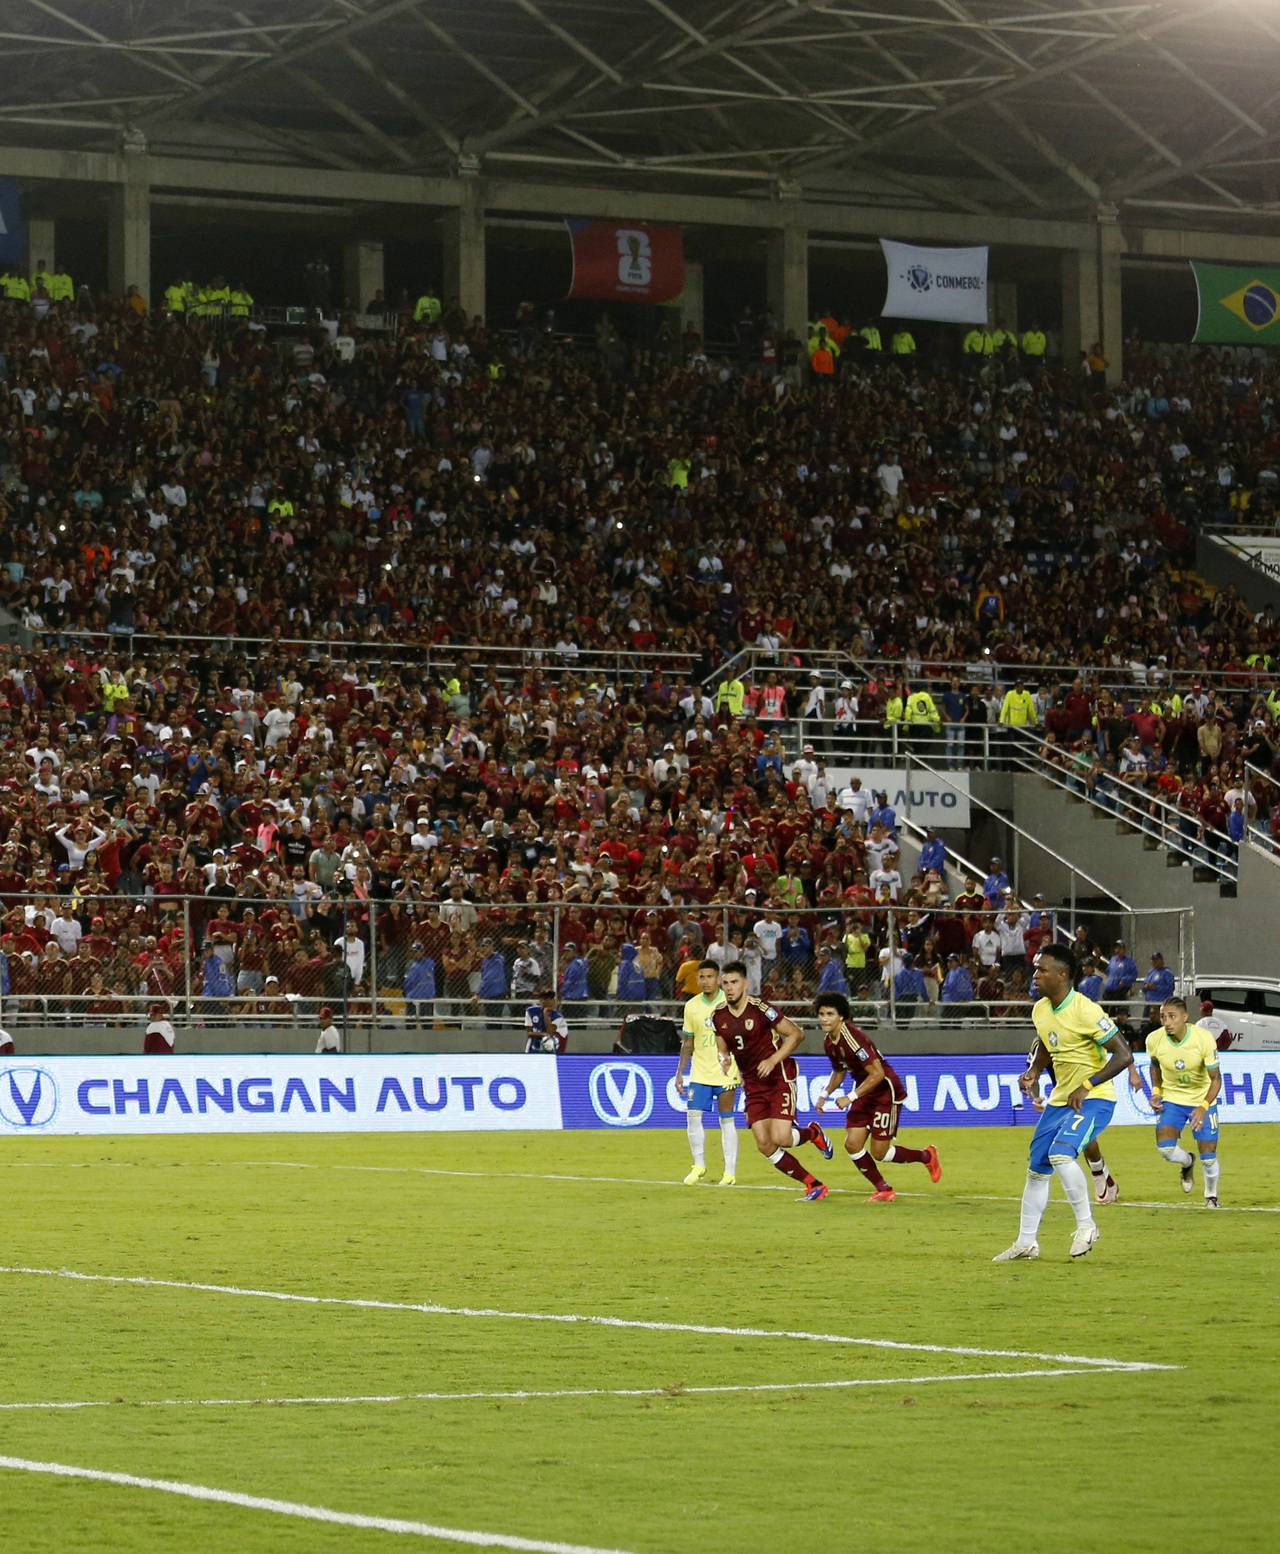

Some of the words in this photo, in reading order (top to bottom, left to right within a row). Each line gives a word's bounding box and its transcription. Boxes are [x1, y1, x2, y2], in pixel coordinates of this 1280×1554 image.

[936, 275, 981, 290] CONMEBOL
[894, 789, 957, 808] AUTO
[734, 1035, 744, 1051] 3
[77, 1077, 356, 1115] CHANGAN
[376, 1076, 527, 1112] AUTO
[781, 1092, 790, 1108] 3
[873, 1112, 890, 1129] 20
[1070, 1114, 1085, 1131] 7
[1208, 1112, 1219, 1130] 10
